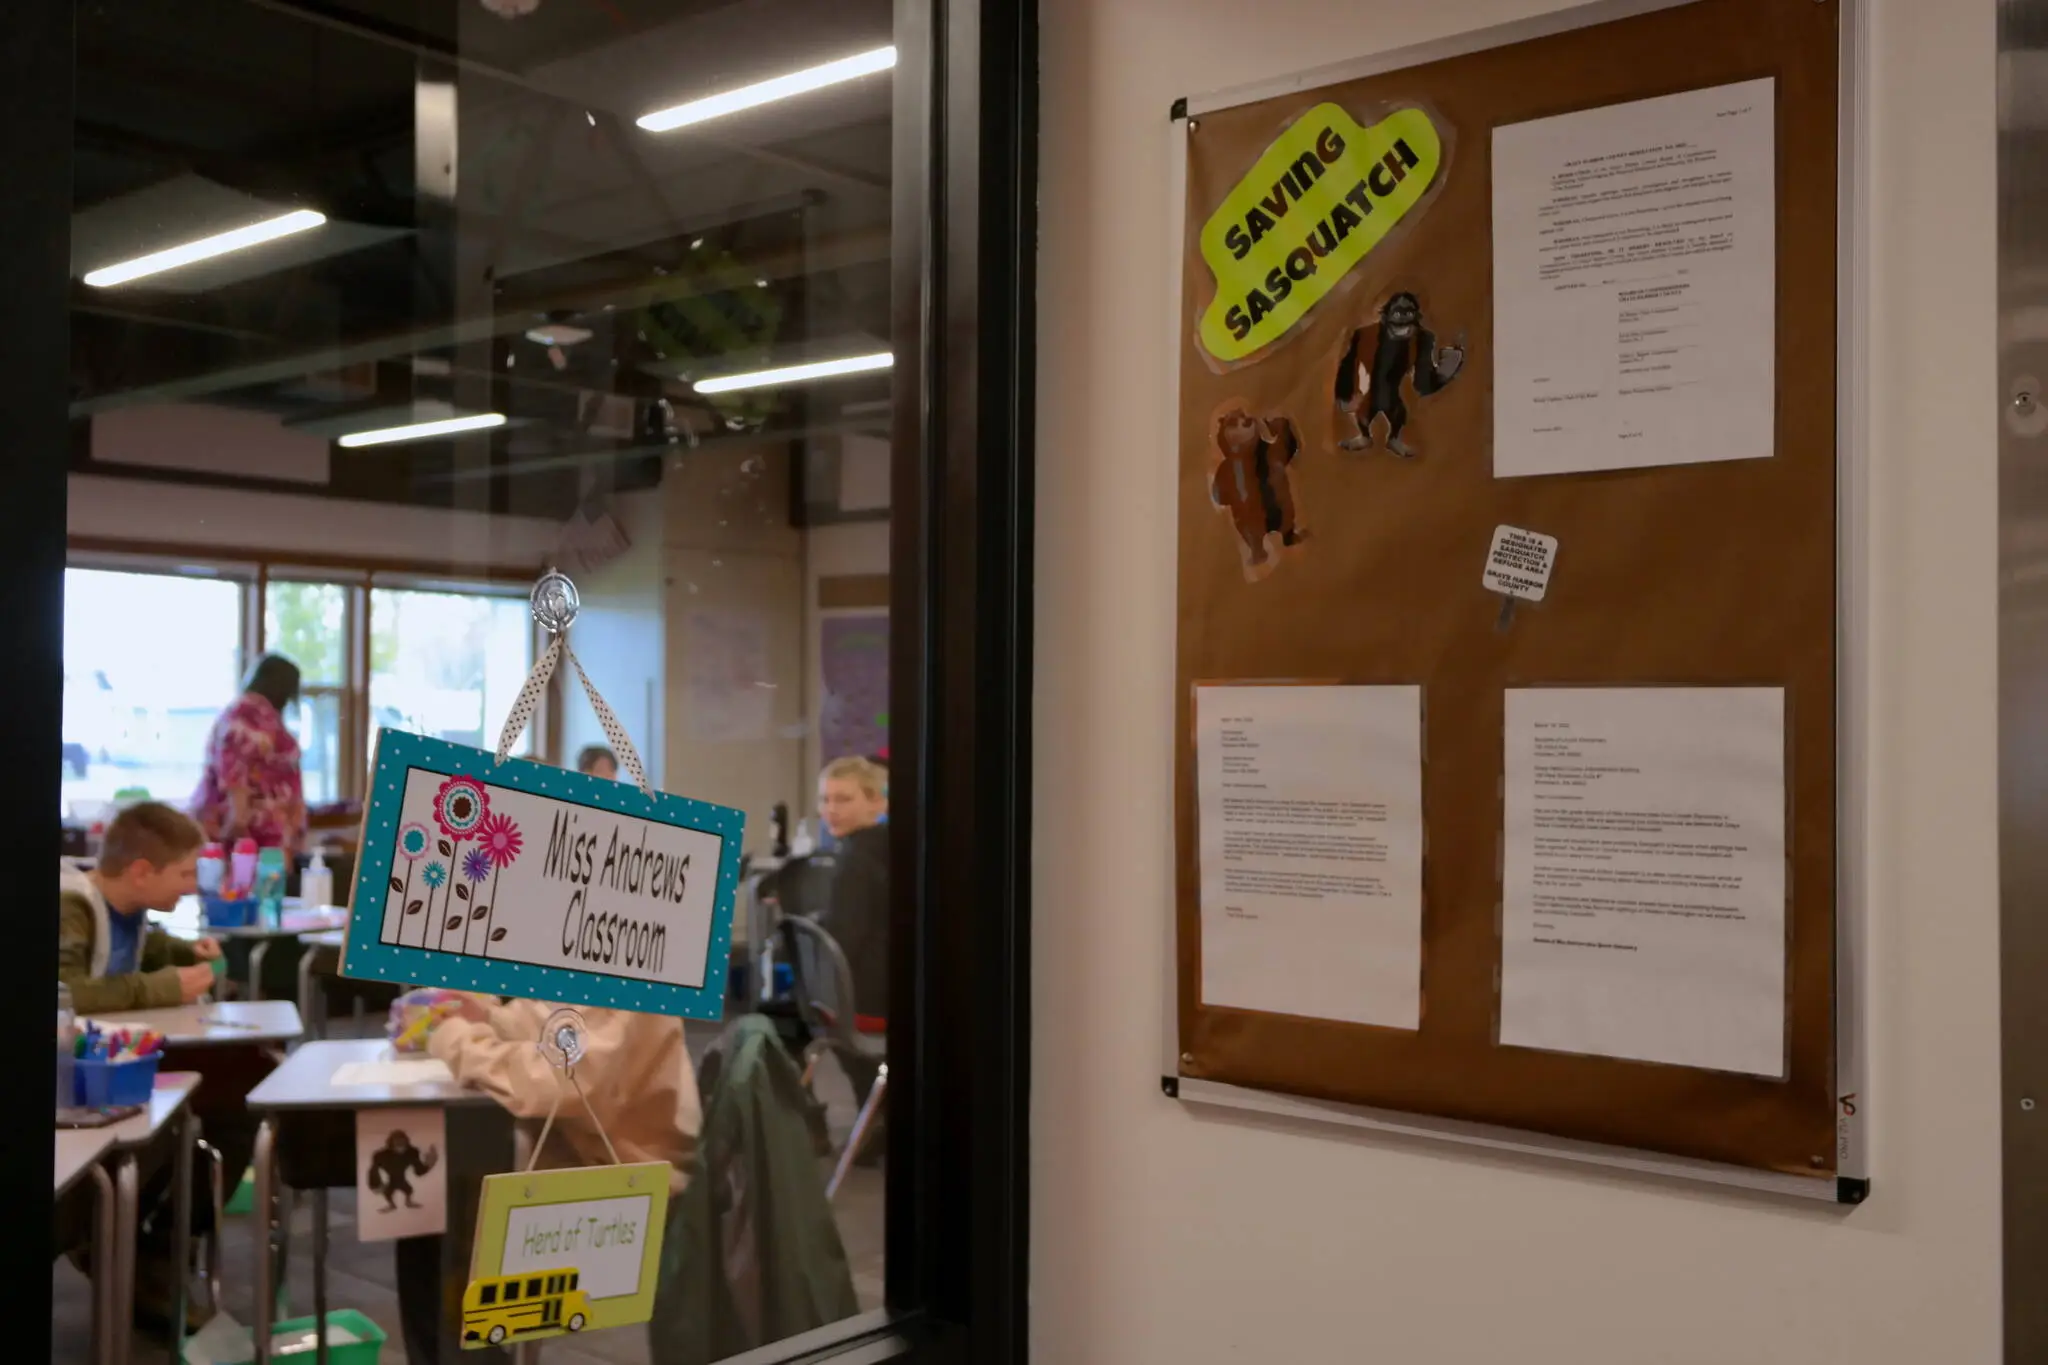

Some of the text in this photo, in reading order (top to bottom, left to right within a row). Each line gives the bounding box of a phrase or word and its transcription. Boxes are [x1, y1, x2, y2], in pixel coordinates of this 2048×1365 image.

[1225, 126, 1346, 261] SAVING
[1225, 137, 1420, 342] SASQUATCH
[1509, 532, 1526, 542] THIS
[1500, 544, 1545, 560] SASQUATCH
[1501, 538, 1547, 554] DESIGNATED
[1493, 550, 1540, 566] PROTECTION
[1493, 557, 1544, 574] REFUGE AREA
[1497, 579, 1530, 592] COUNTY
[1512, 576, 1544, 590] HARBOR
[543, 808, 690, 904] Miss Andrews
[562, 886, 666, 973] Classroom
[523, 1212, 637, 1257] Herd of Turtles
